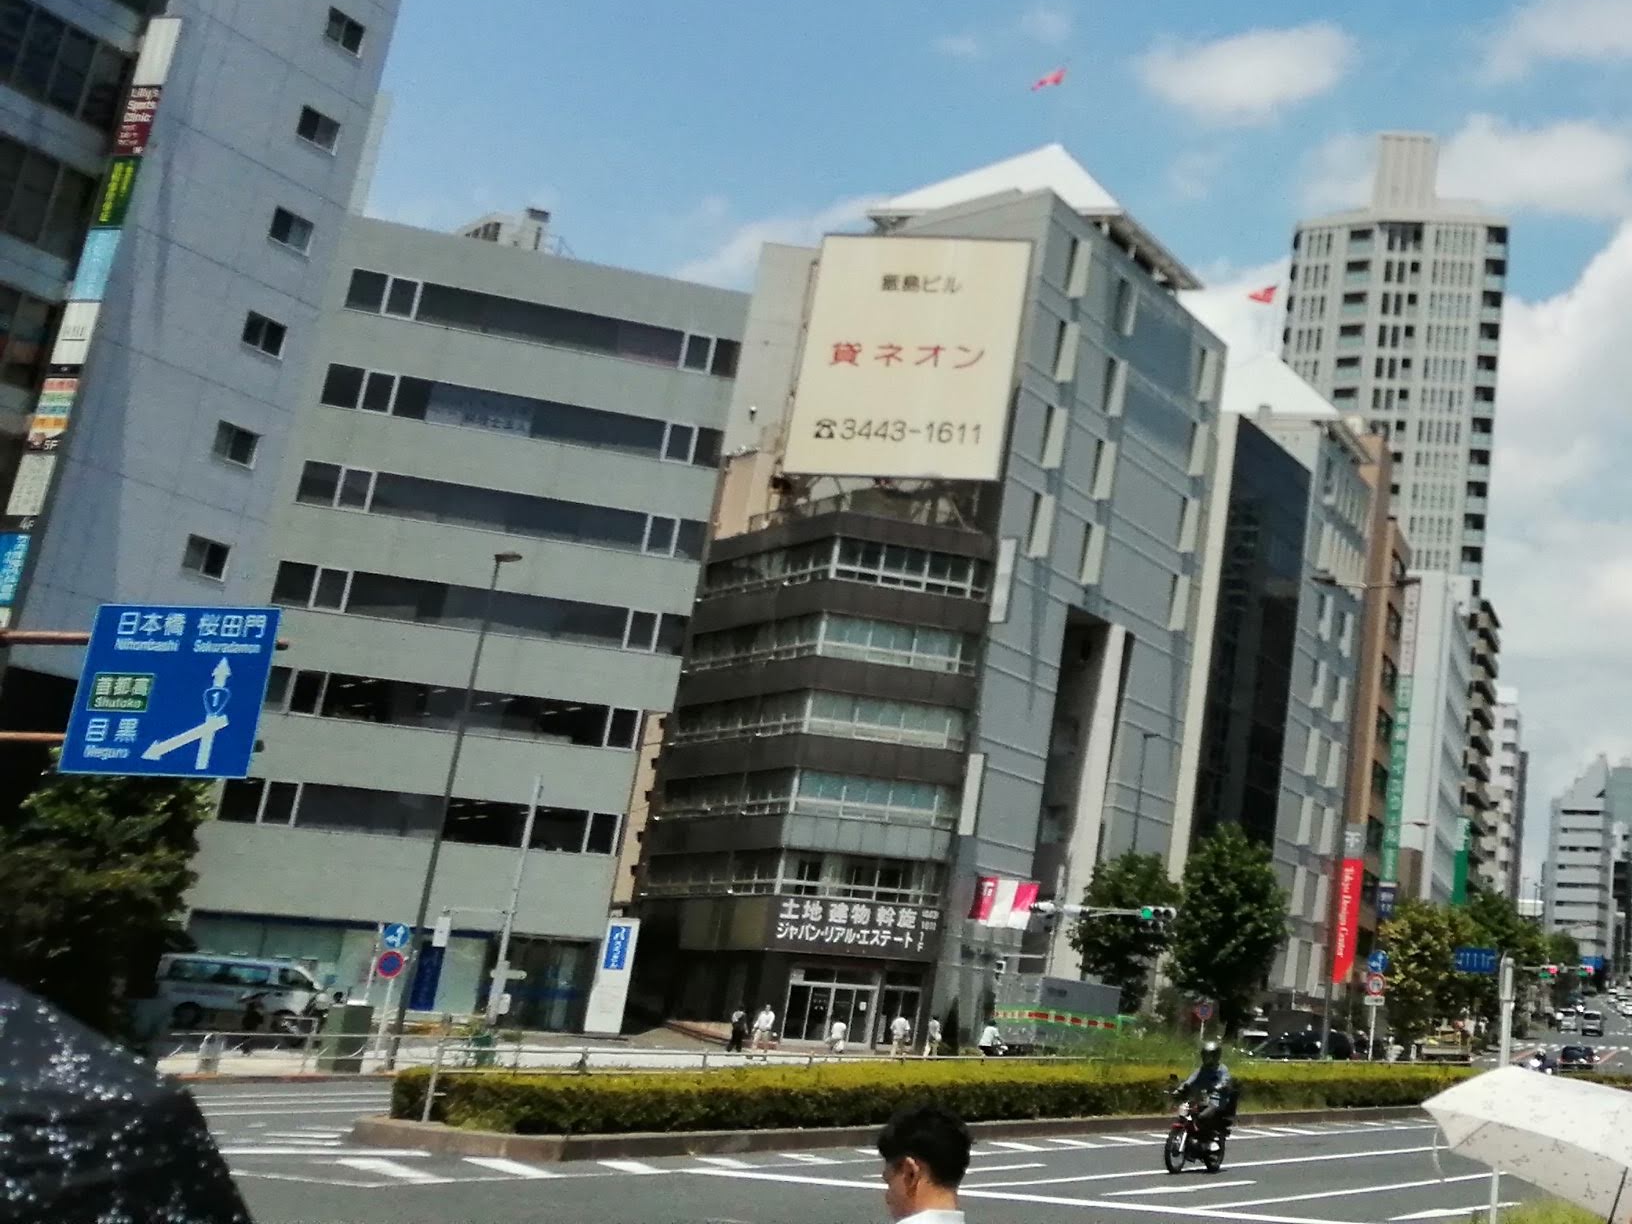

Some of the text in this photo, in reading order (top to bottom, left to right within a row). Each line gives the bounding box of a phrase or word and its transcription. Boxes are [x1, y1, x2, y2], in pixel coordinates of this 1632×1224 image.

[829, 342, 986, 370] 貸ネオン
[839, 418, 983, 445] 3443-1611
[117, 611, 268, 638] 日本橋 桜田門
[95, 677, 150, 696] 首都高
[85, 718, 139, 743] 目黒
[83, 745, 131, 761] Meguro
